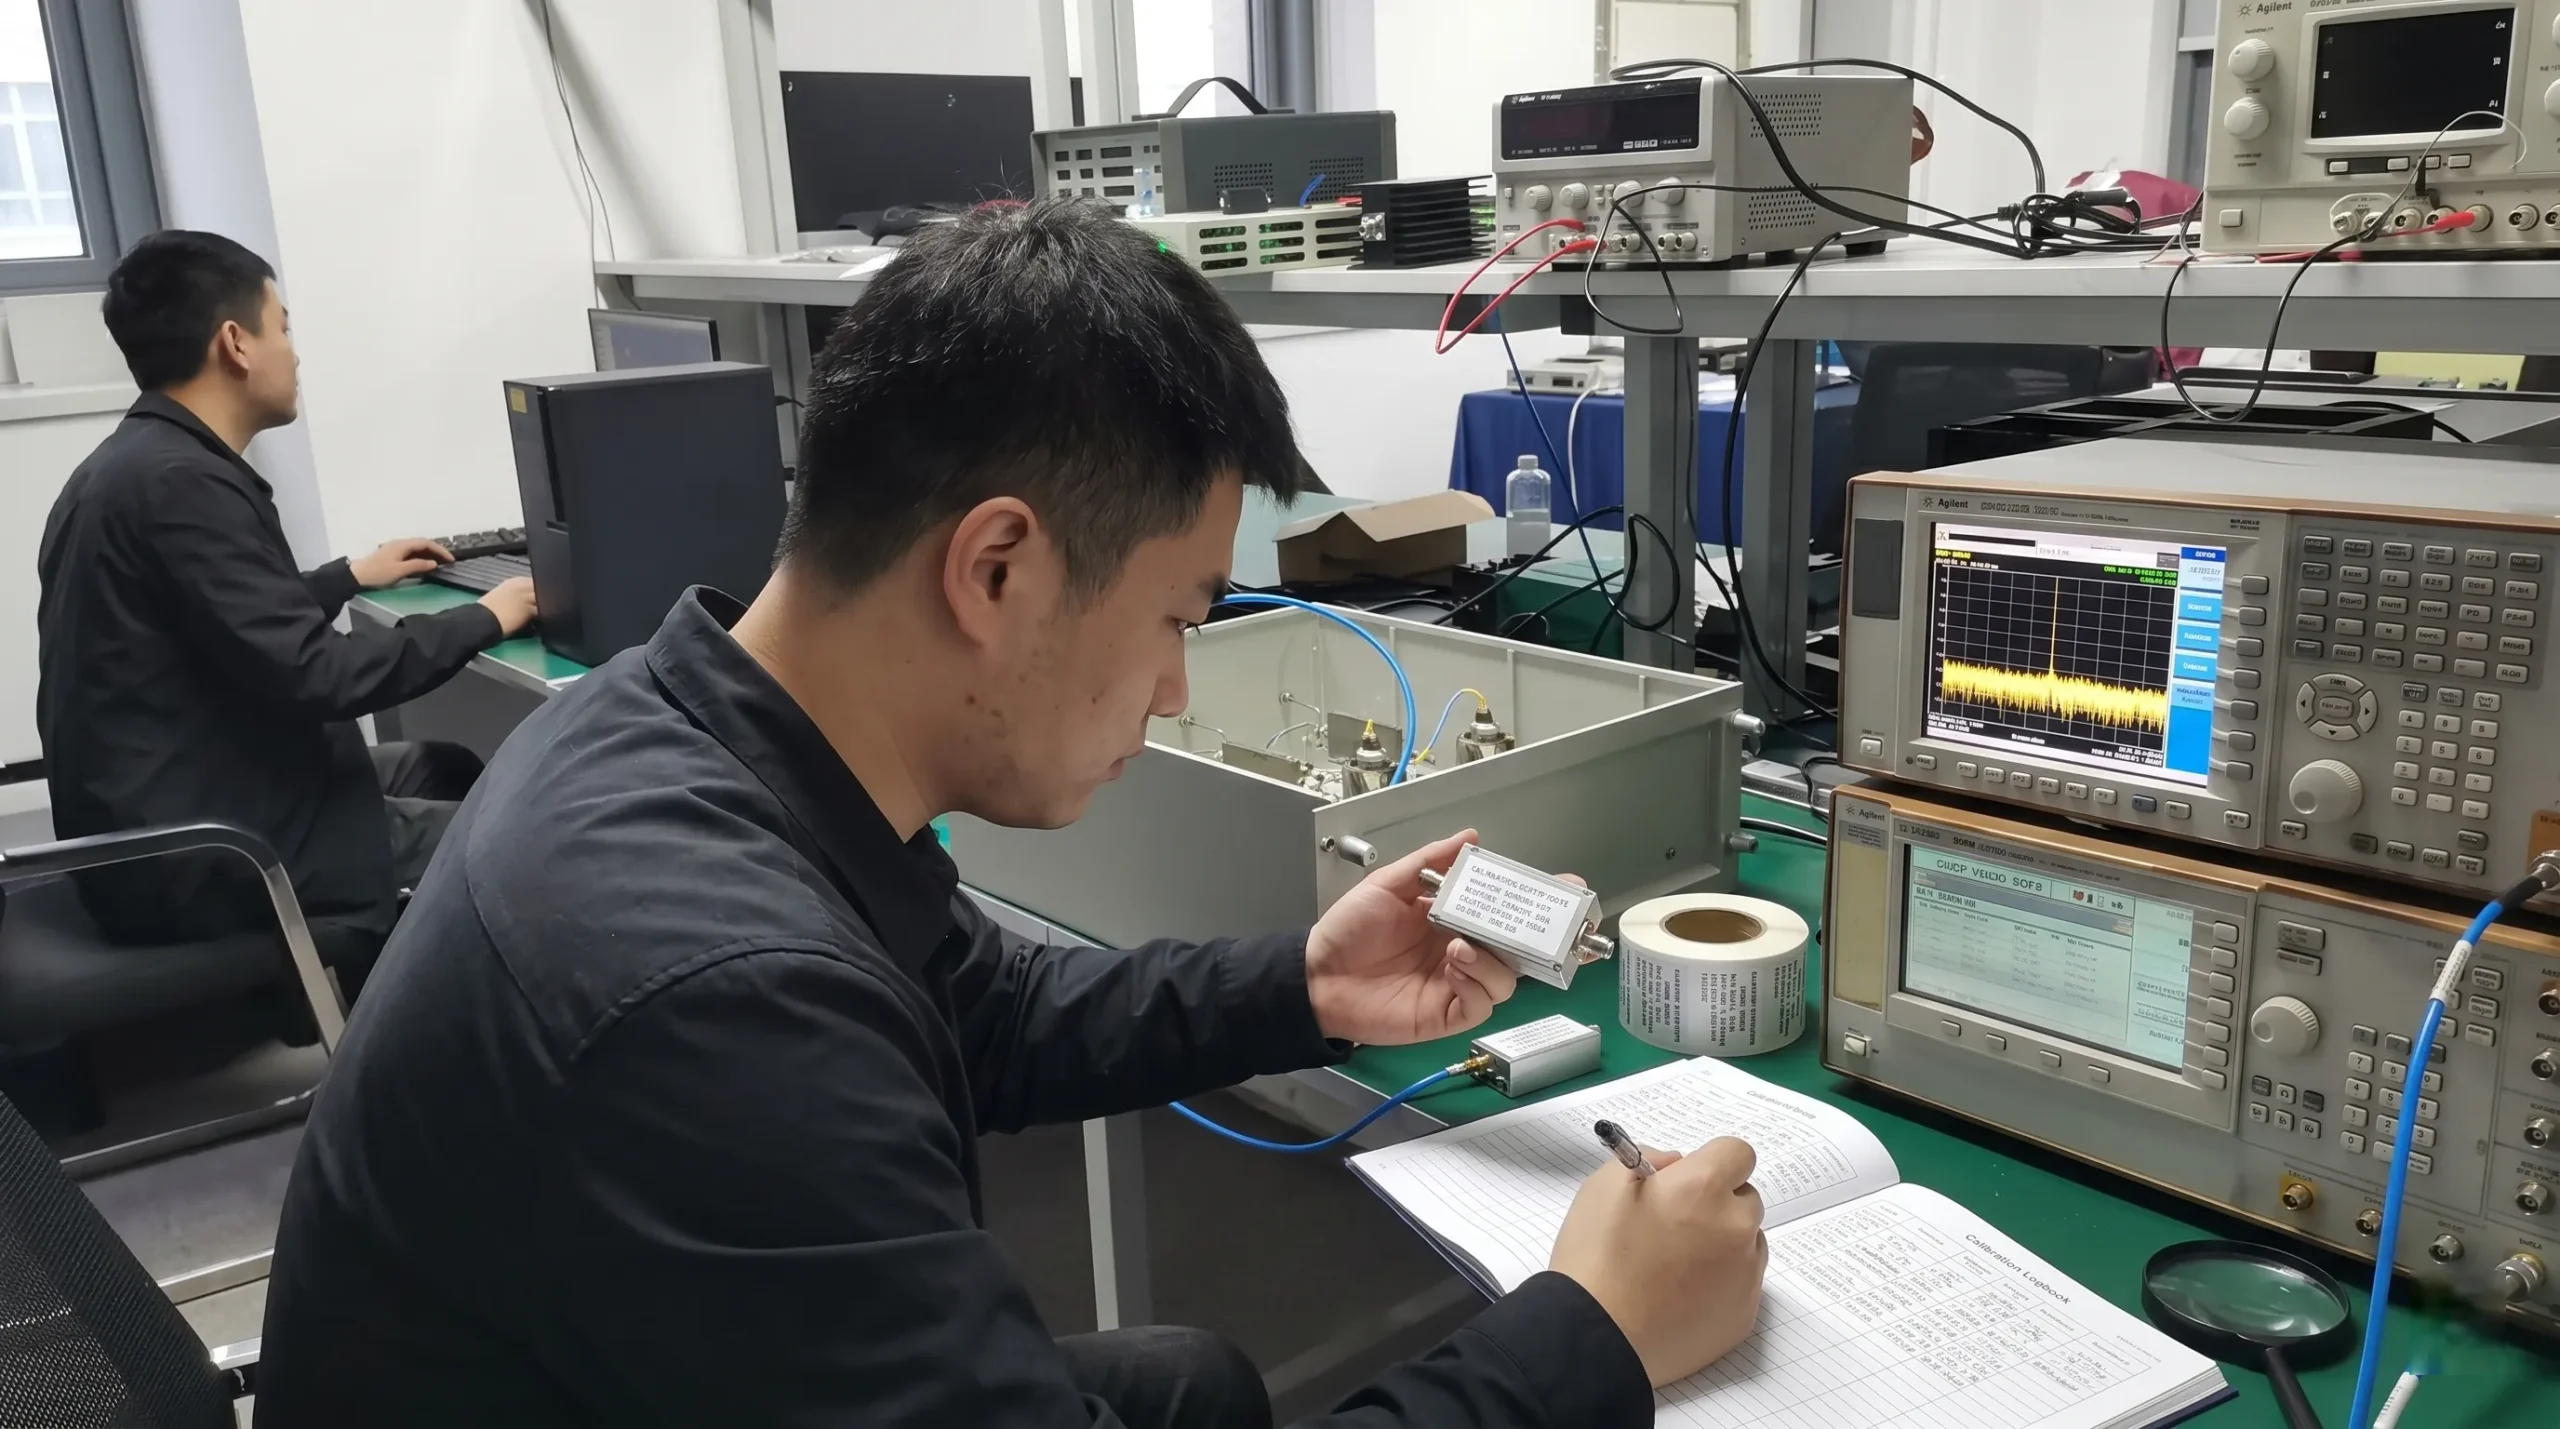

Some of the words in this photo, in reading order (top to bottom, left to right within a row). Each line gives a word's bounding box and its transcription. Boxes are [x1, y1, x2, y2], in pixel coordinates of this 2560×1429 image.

[2257, 1, 2292, 15] Agilent
[1938, 498, 1968, 509] Agilent
[2439, 746, 2445, 754] 5
[2357, 1057, 2363, 1065] 7
[2353, 1083, 2359, 1091] 4
[2387, 1093, 2394, 1101] 5
[2420, 1102, 2427, 1111] 6
[2385, 1120, 2391, 1128] 2
[2417, 1130, 2424, 1138] 3
[2347, 1136, 2354, 1144] 0
[1965, 1233, 2022, 1273] Calibration
[2022, 1271, 2072, 1305] Logbook
